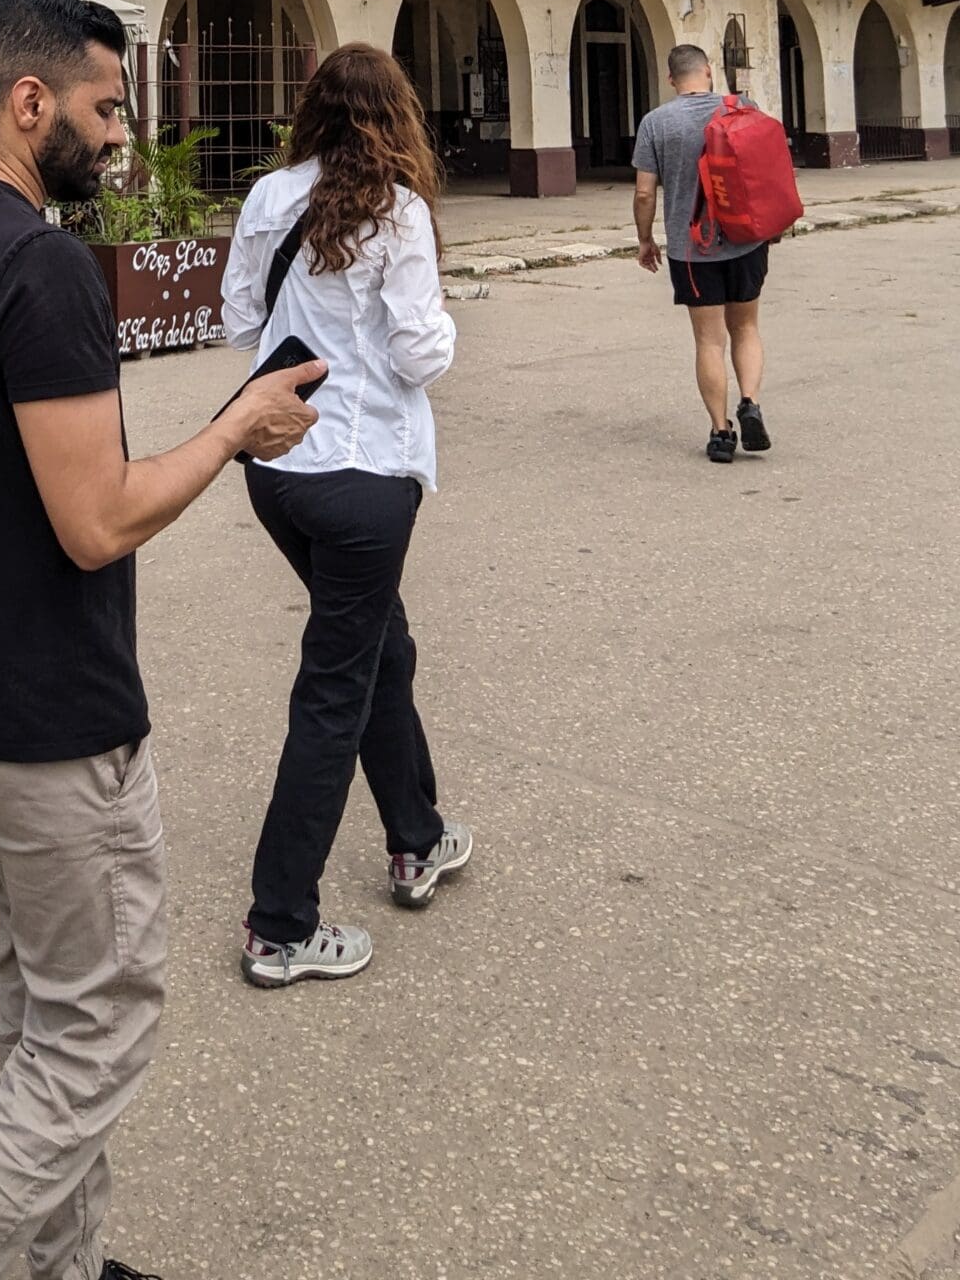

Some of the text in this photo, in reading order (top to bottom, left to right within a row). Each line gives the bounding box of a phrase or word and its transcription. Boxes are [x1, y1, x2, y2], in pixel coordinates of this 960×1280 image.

[132, 242, 171, 280] Chez
[164, 314, 180, 347] de
[180, 311, 195, 345] la
